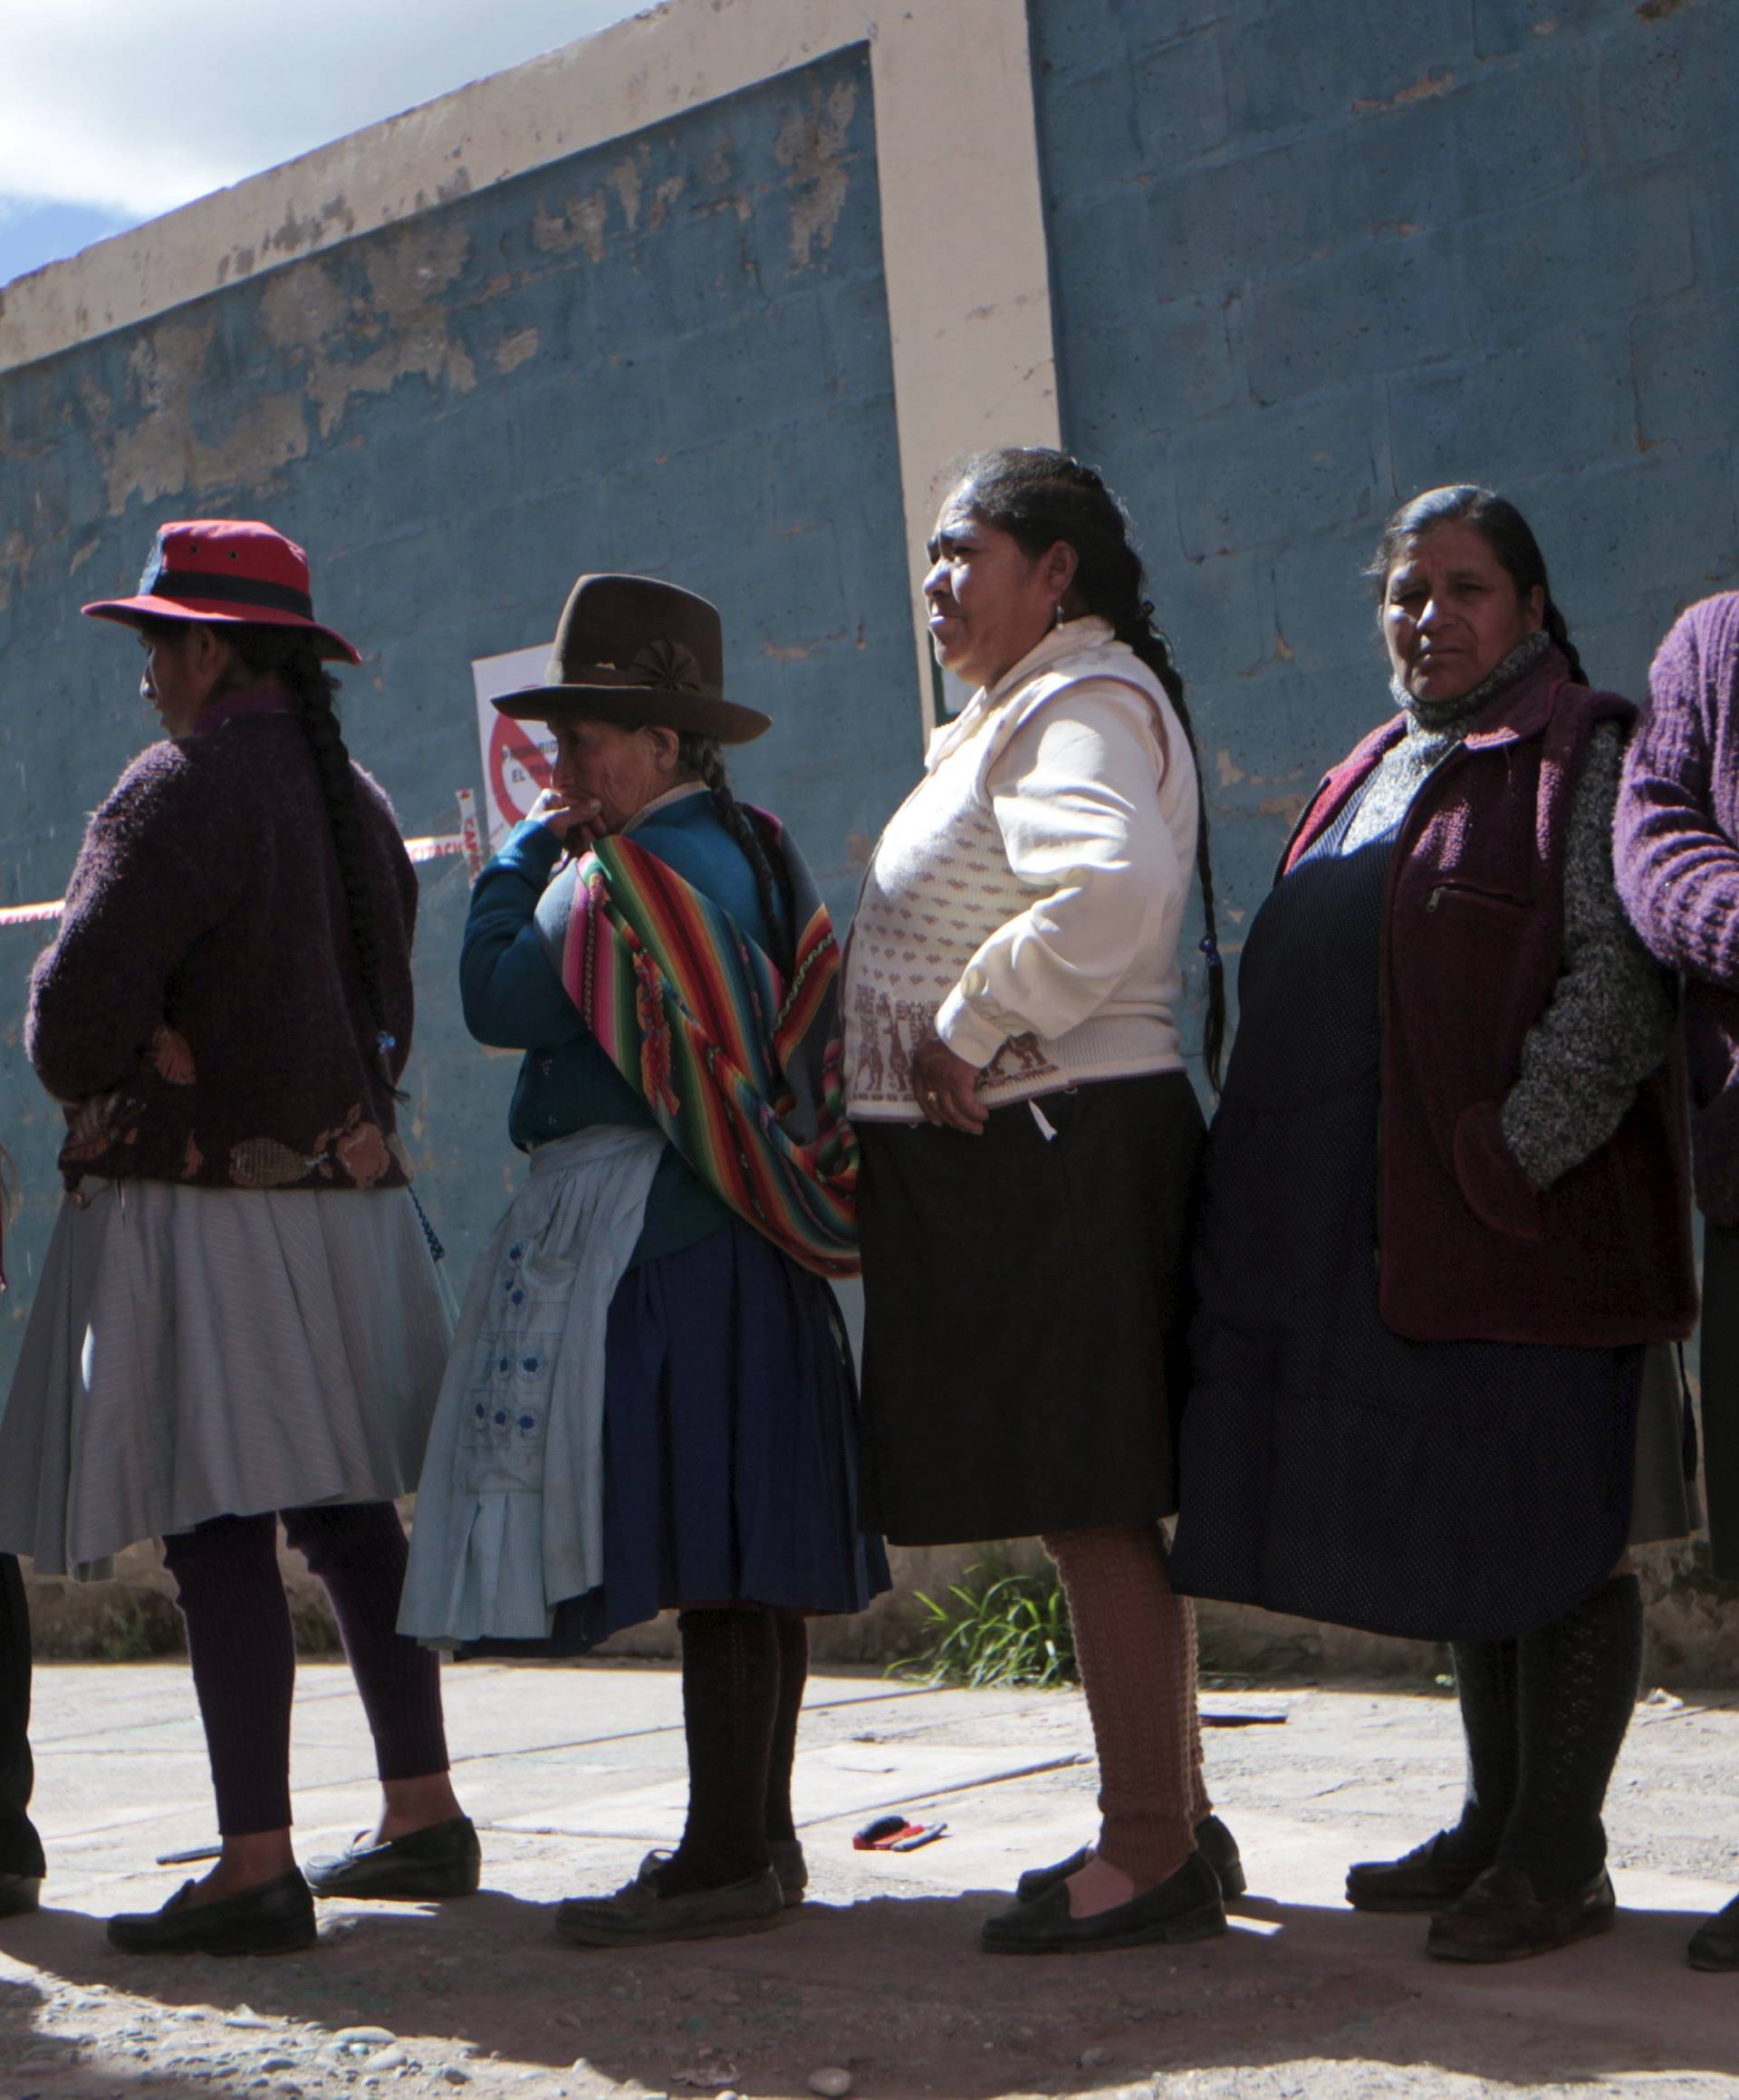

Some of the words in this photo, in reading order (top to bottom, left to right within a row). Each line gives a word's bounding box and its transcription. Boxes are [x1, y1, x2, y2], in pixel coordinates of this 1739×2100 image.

[502, 739, 559, 762] PROHIBID
[512, 768, 526, 783] EL
[410, 841, 465, 860] CITACI
